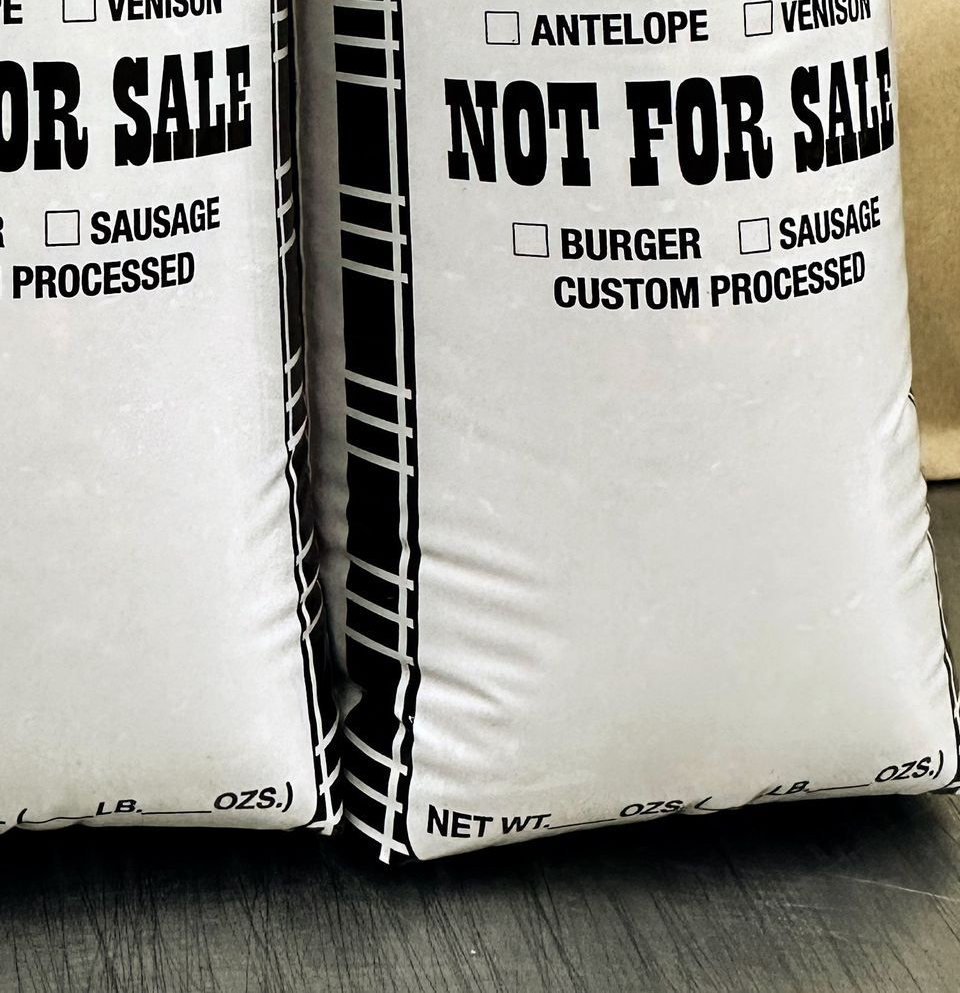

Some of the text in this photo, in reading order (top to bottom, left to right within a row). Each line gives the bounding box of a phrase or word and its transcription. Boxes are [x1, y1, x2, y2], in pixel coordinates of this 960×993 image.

[532, 10, 708, 45] ANTELOPE
[113, 45, 251, 166] SALE
[444, 47, 894, 186] NOT FOR SALE
[91, 197, 220, 244] SAUSAGE
[561, 196, 880, 261] BURGER SAUSAGE
[13, 252, 194, 298] PROCESSED
[554, 252, 865, 309] CUSTOM PROCESSED
[96, 799, 143, 816] LB.
[213, 782, 293, 812] OZS.)
[426, 805, 493, 838] NET
[501, 814, 550, 832] WT.
[875, 750, 943, 784] OZS.)
